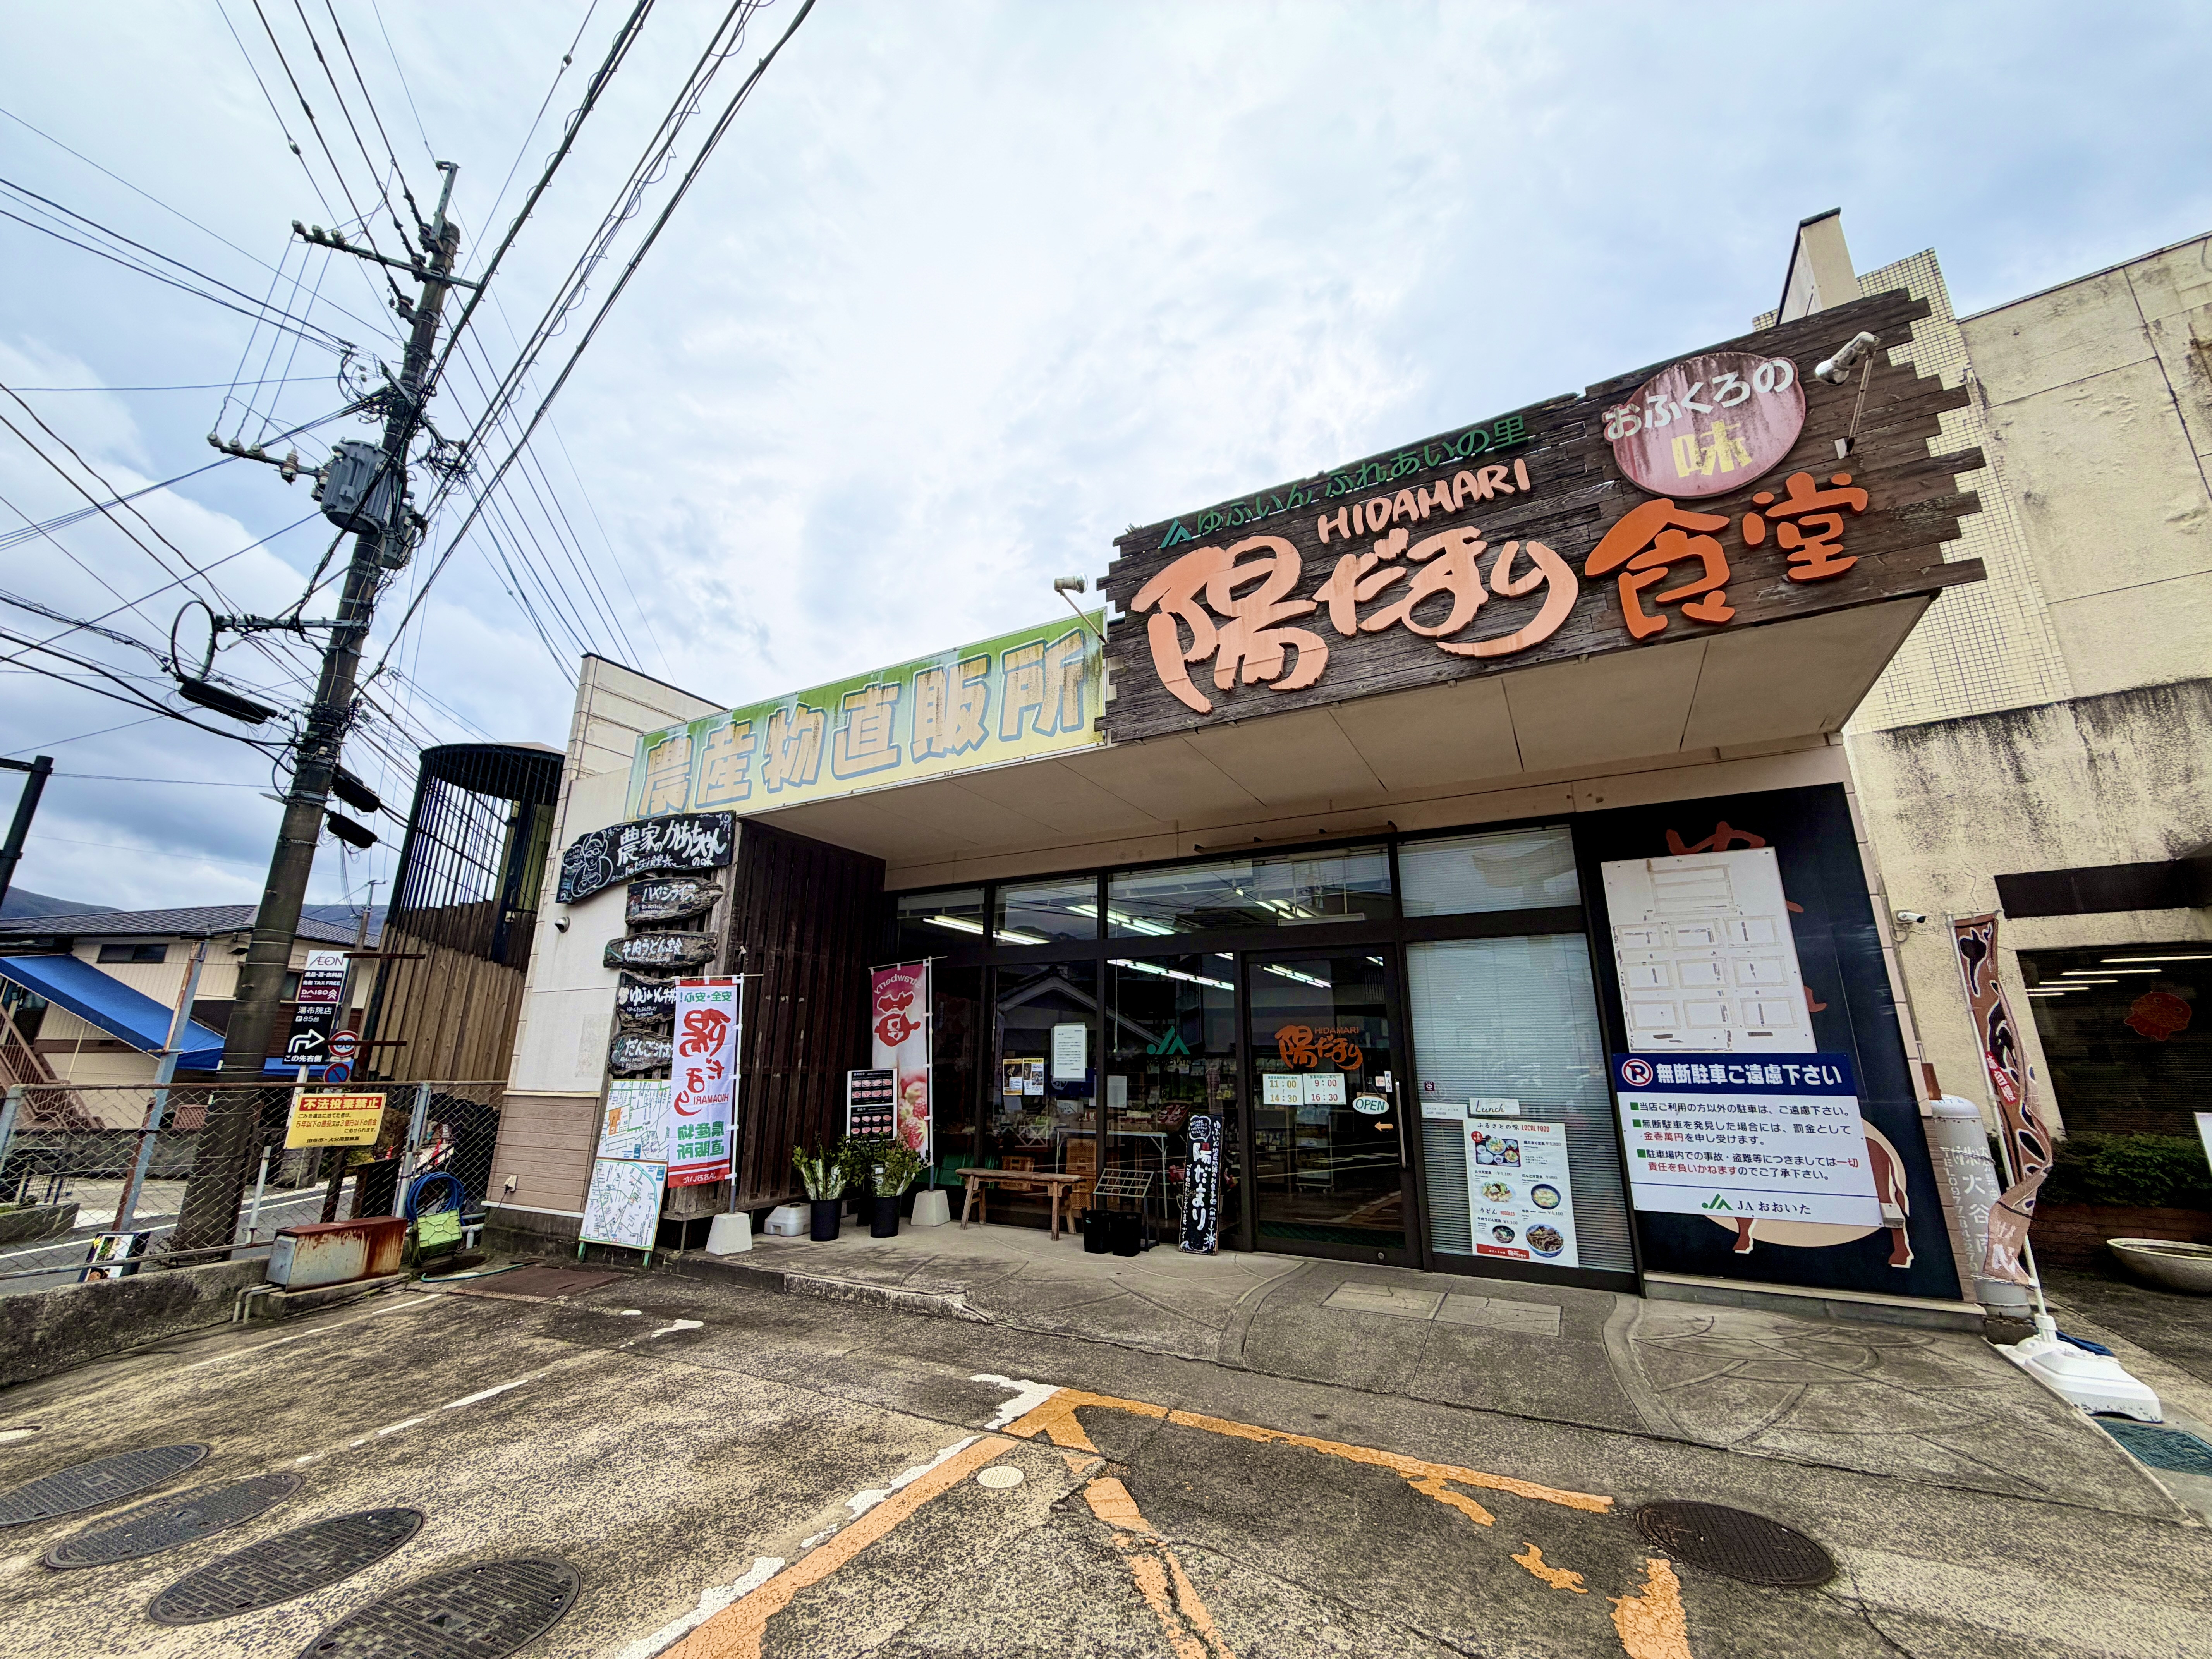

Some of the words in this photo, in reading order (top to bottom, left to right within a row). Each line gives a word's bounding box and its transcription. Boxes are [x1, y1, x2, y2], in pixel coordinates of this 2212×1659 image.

[1603, 355, 1795, 442] おふくろの
[1669, 419, 1752, 478] 味
[1197, 484, 1312, 536] ゆふいん
[1325, 414, 1529, 498] ふれあいの里
[1317, 458, 1532, 544] HIDAMARI
[637, 627, 1086, 819] 農産物直販所
[617, 819, 727, 867] 農家のかあちゃん
[641, 884, 697, 902] ハヤシライス
[622, 936, 683, 959] 牛肉うどん定食
[297, 1006, 333, 1015] 湯布院店
[1314, 1026, 1360, 1034] HIDAMARI
[625, 1038, 674, 1058] だんご汁定
[1274, 1025, 1364, 1070] 陽だまり
[1656, 1063, 1843, 1085] 無断駐車ご遠慮下さい
[1269, 1080, 1297, 1088] 11:00
[303, 1097, 379, 1109] 不法投棄禁止
[1270, 1094, 1297, 1103] 14:30
[1311, 1093, 1338, 1101] 16:30
[1355, 1099, 1386, 1111] OPEN
[1475, 1099, 1505, 1113] Lunch
[1640, 1102, 1850, 1117] 当店ご利用の方以外の駐車は、ご遠慮下さい。
[1477, 1122, 1519, 1130] ふるさとの味
[1642, 1119, 1851, 1135] 無断駐車を発見した場合には、罰金として
[1644, 1131, 1765, 1146] 金壱萬円を申し受けます。
[1646, 1149, 1859, 1168] 駐車場内での事故・盗難等につきましては一切
[1648, 1162, 1829, 1181] 責任を負いかねますのでご了承下さい。
